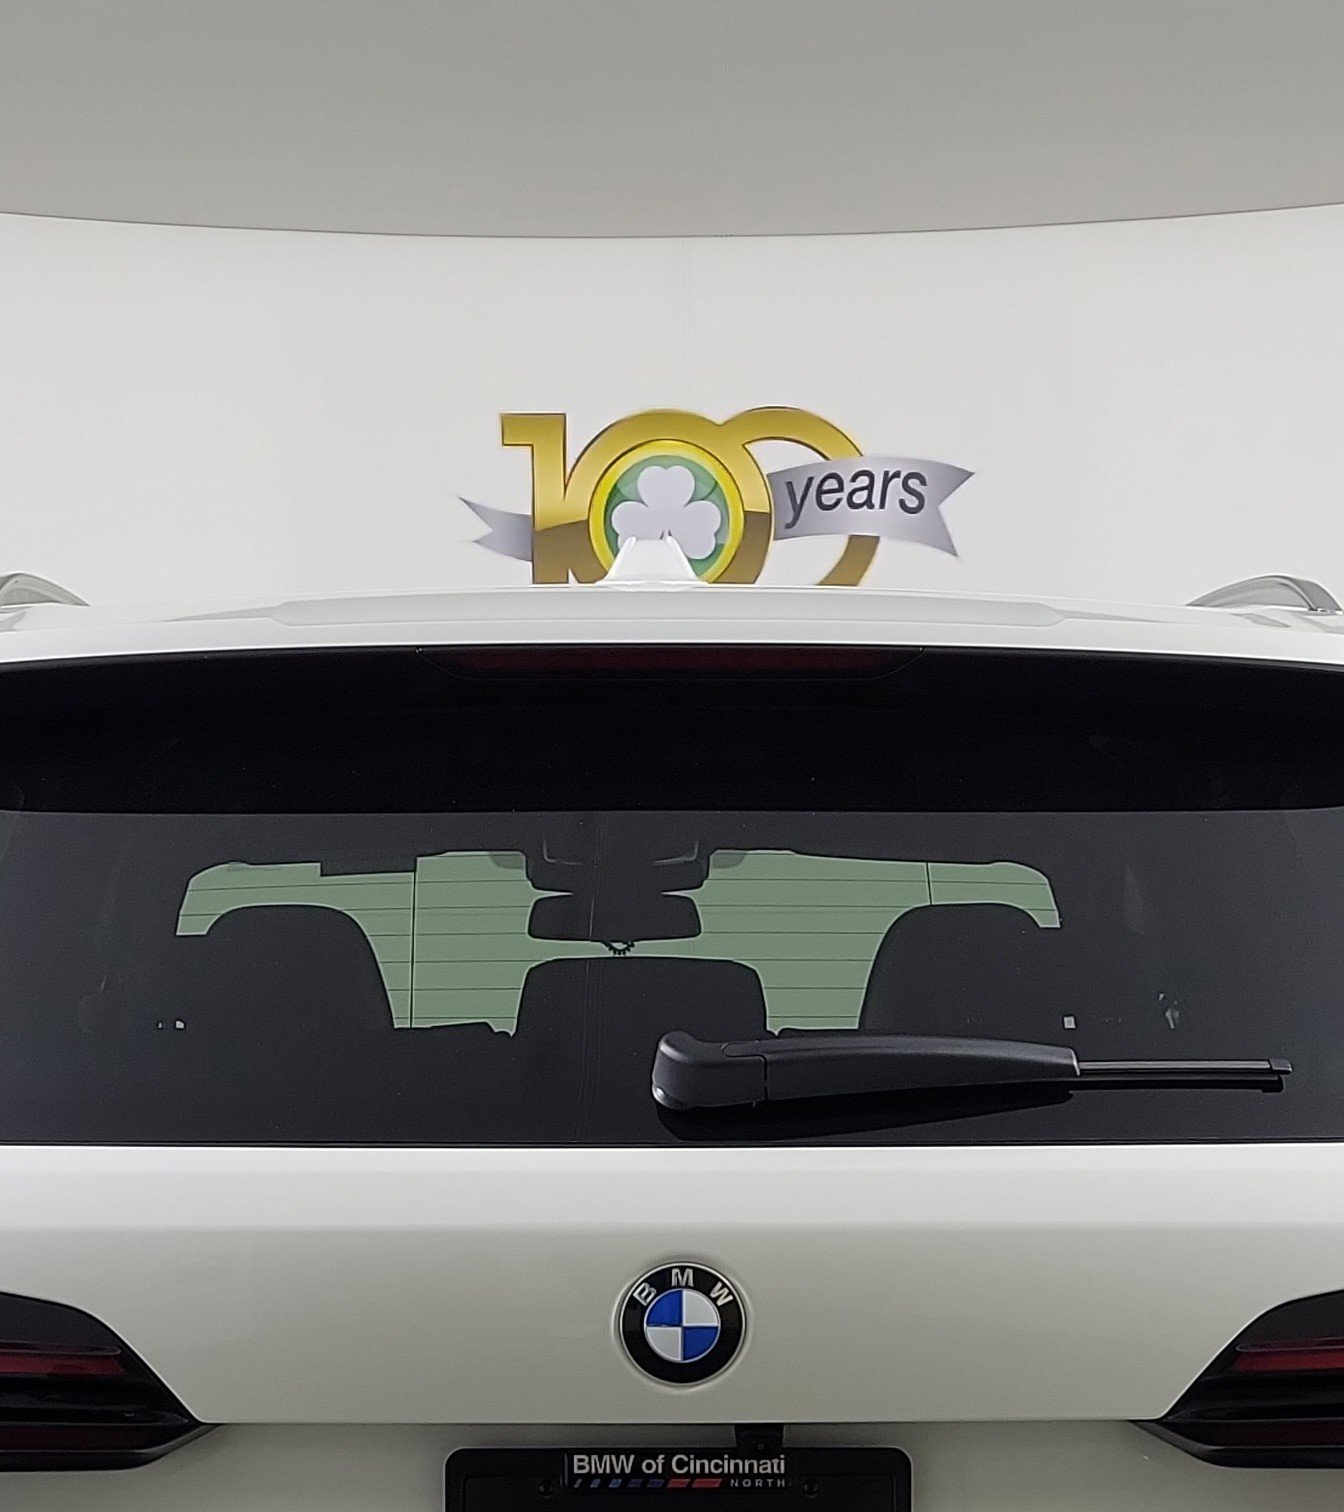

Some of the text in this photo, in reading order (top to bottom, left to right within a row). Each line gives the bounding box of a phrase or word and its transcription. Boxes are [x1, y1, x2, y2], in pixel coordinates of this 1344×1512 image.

[500, 406, 927, 584] 100 years
[633, 1268, 733, 1306] BMW
[573, 1454, 786, 1474] BMW of Cincinnati
[730, 1478, 786, 1488] NORTH
